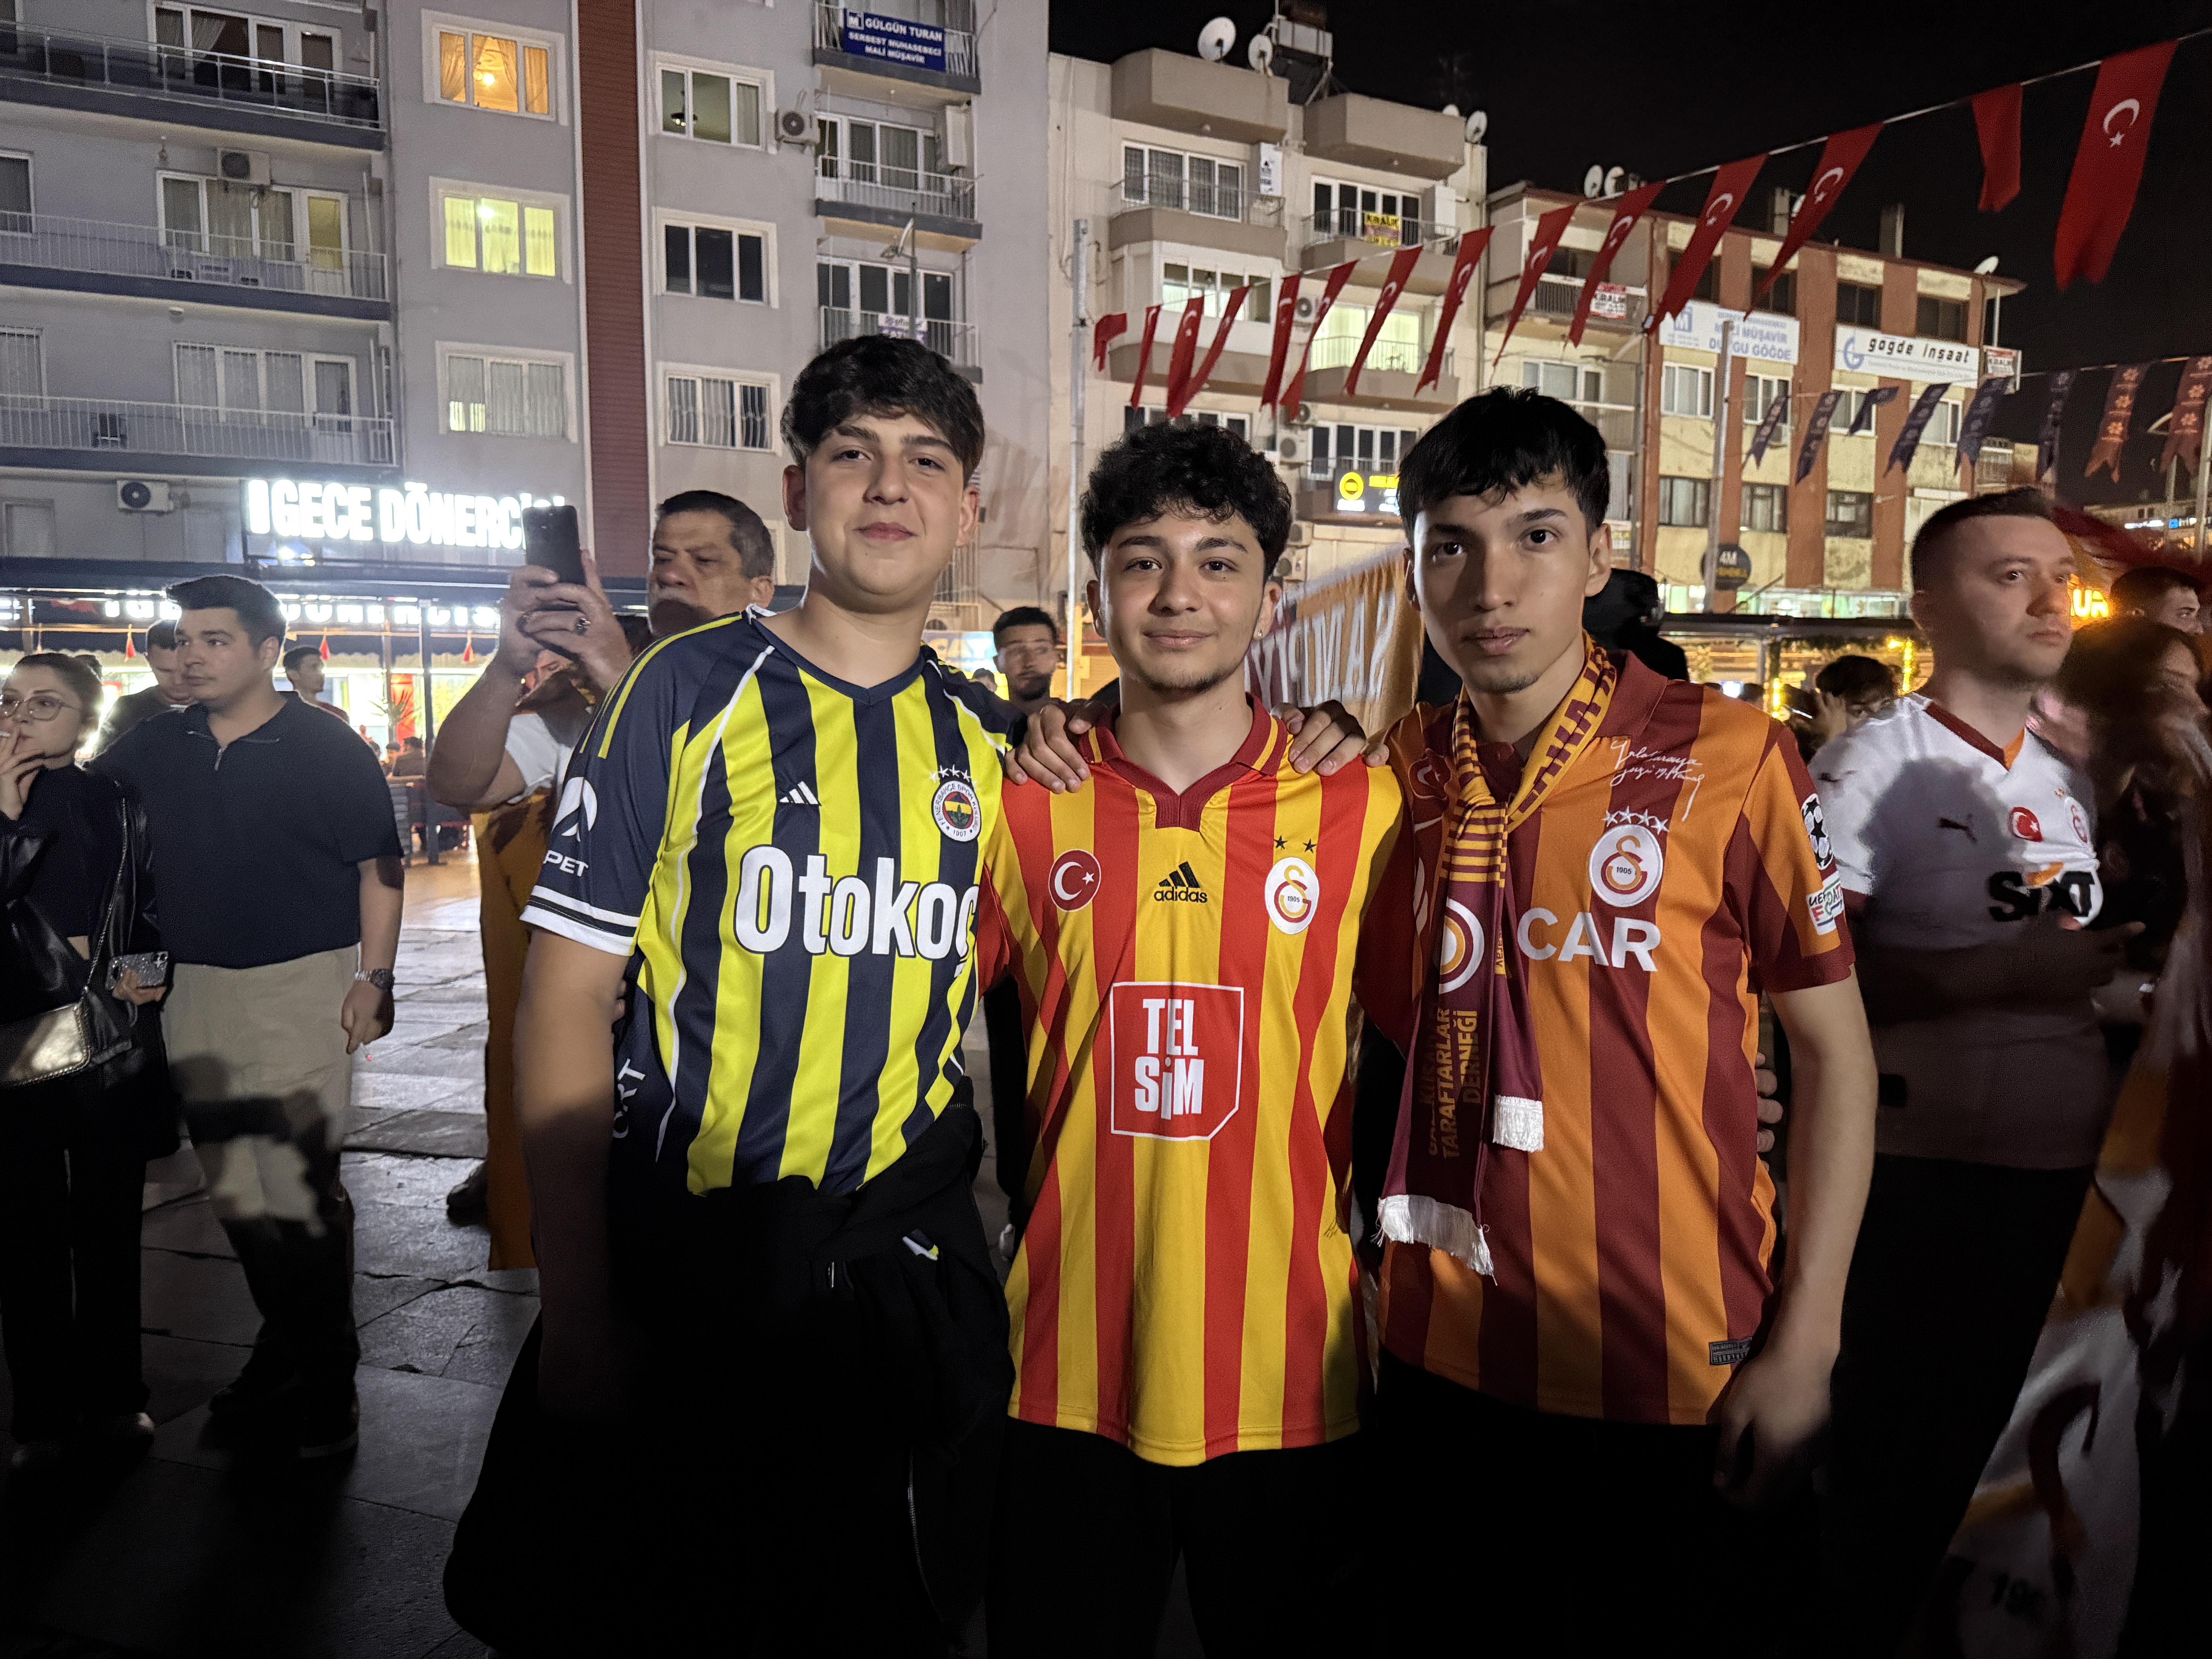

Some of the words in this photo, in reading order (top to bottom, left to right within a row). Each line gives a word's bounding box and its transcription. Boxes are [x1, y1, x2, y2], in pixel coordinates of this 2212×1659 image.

[866, 18, 907, 35] GÜLGÜN
[909, 27, 942, 41] TURAN
[543, 850, 588, 877] PET
[1616, 866, 1632, 874] 1905
[1154, 887, 1208, 903] adidas
[1517, 907, 1661, 972] CAR
[1143, 998, 1199, 1056] TEL
[1437, 1008, 1460, 1160] TARAFTARLAR
